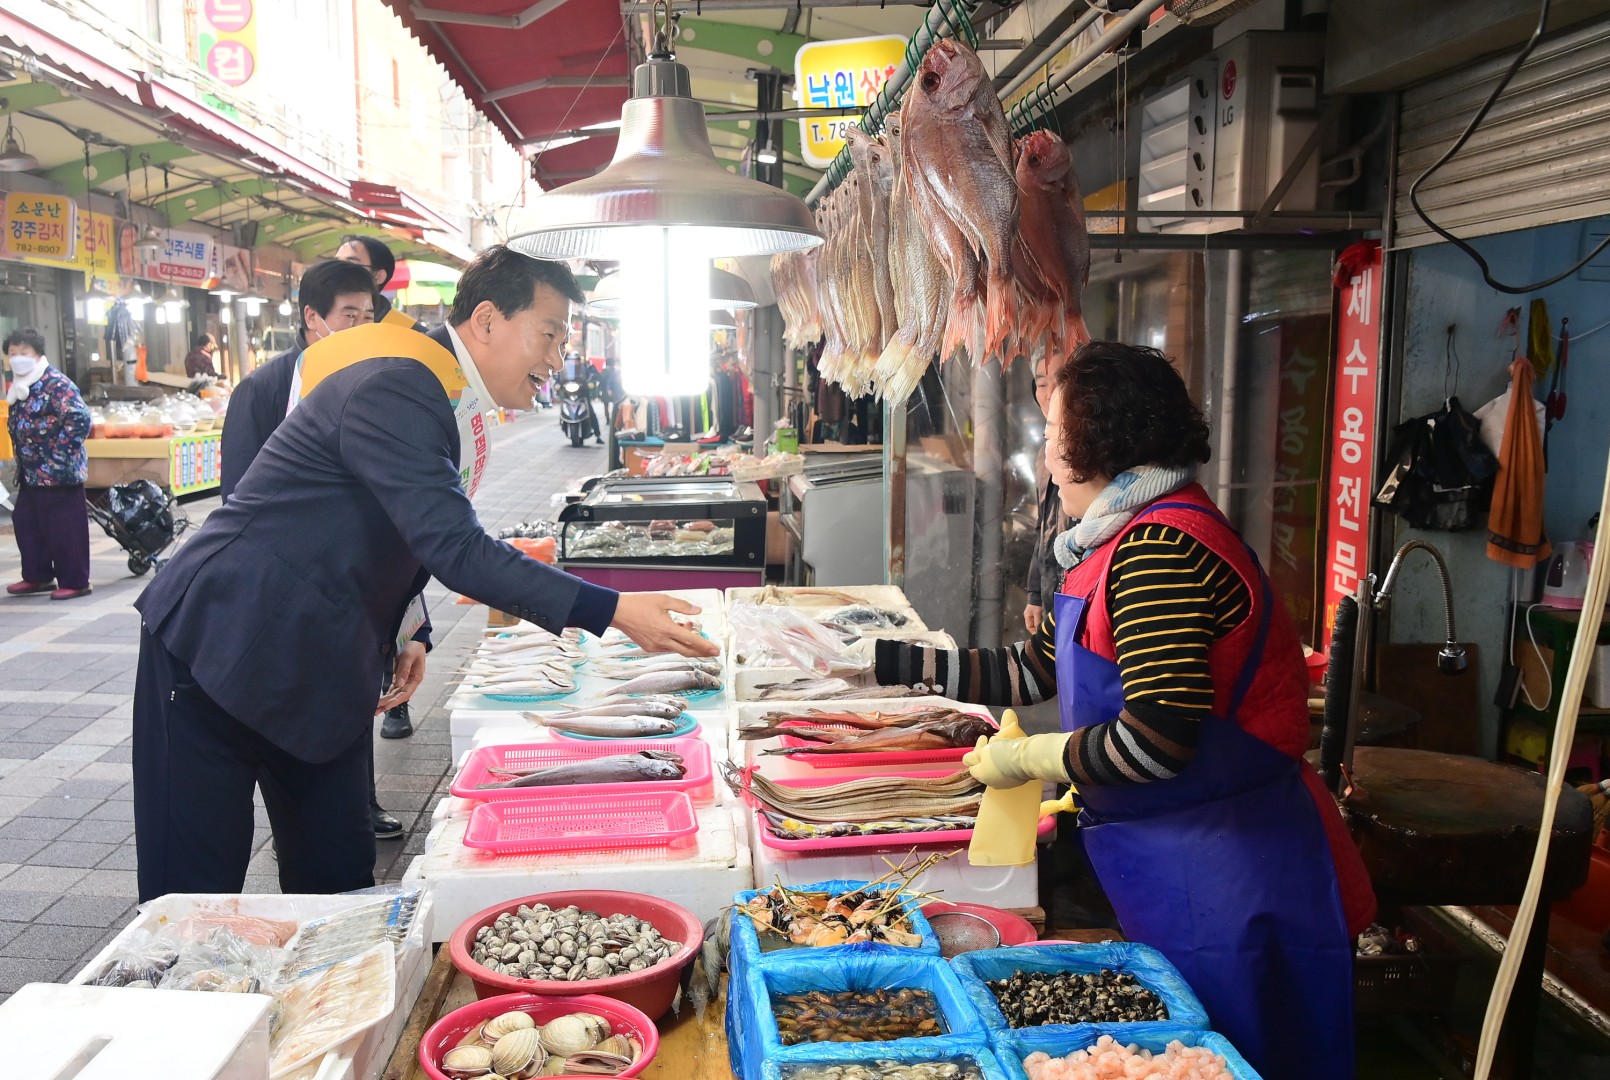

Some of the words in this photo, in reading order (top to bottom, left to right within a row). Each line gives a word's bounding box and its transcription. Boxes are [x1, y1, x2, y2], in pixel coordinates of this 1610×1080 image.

[808, 72, 856, 108] 낙원
[860, 66, 896, 107] 상
[1222, 105, 1234, 127] LG
[15, 201, 61, 218] 소문난
[11, 220, 64, 242] 경주김치
[16, 243, 61, 254] 782-8007
